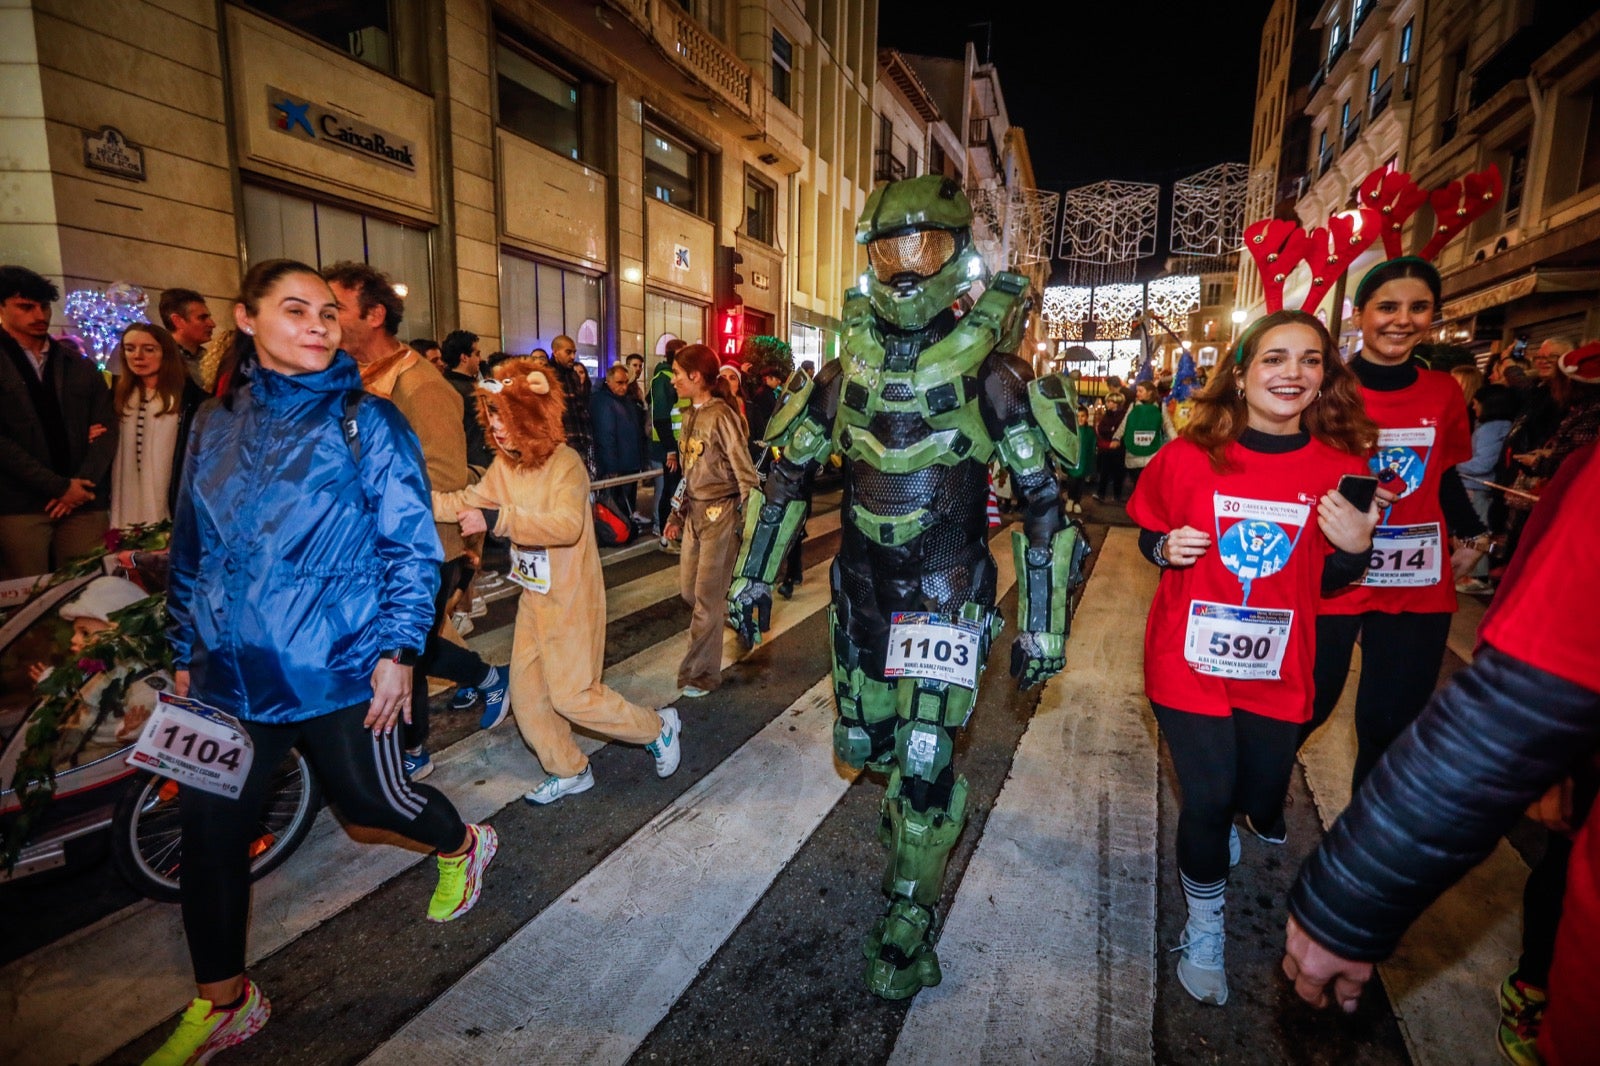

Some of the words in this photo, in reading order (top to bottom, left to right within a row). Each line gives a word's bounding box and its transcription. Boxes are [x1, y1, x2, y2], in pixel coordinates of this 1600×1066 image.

[320, 114, 415, 167] CaixaBank
[1222, 500, 1240, 512] 30
[517, 558, 537, 578] 61
[1368, 549, 1425, 570] 614
[900, 637, 969, 666] 1103
[1208, 631, 1271, 660] 590
[164, 725, 242, 771] 1104
